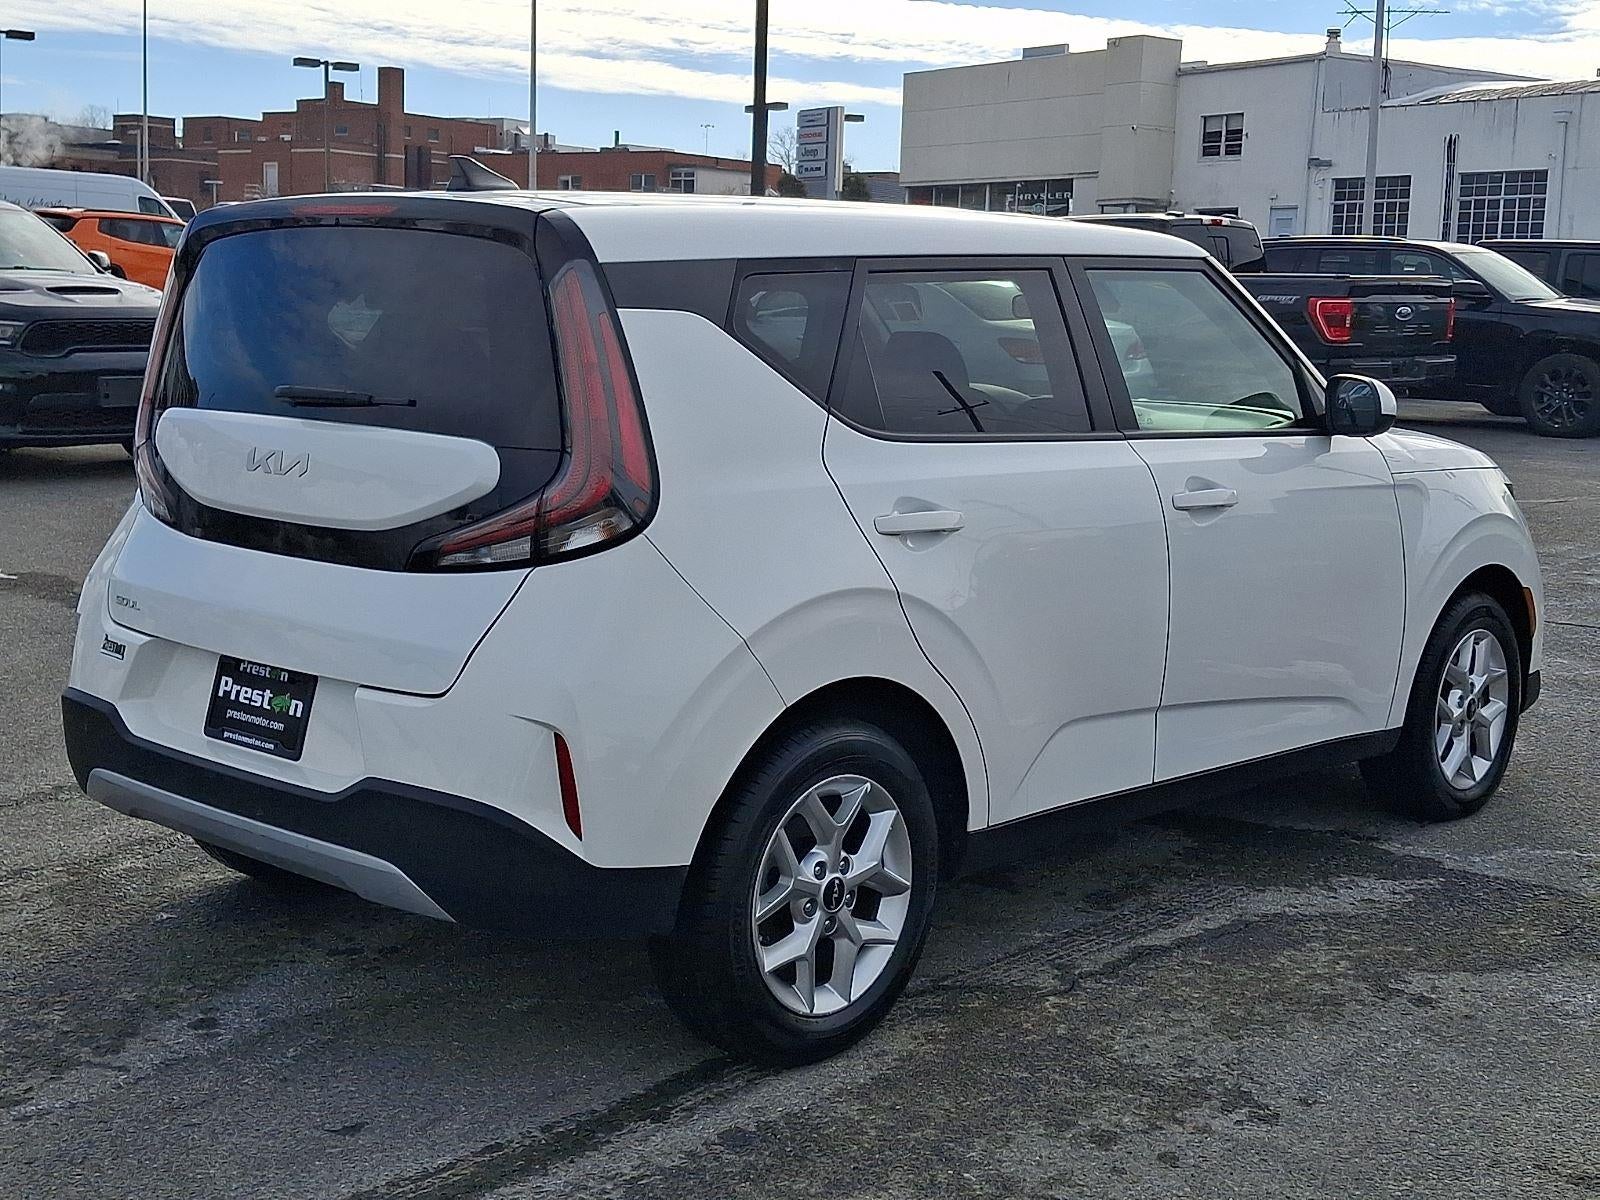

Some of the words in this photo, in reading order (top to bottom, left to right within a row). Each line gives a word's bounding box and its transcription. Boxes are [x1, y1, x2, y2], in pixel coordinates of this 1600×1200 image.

[801, 147, 819, 158] Jeep
[246, 446, 310, 478] KIA
[116, 595, 141, 611] SOUL
[218, 676, 304, 718] Preston
[226, 709, 285, 731] prestonmotor.com
[223, 731, 275, 750] prestonmotor.com
